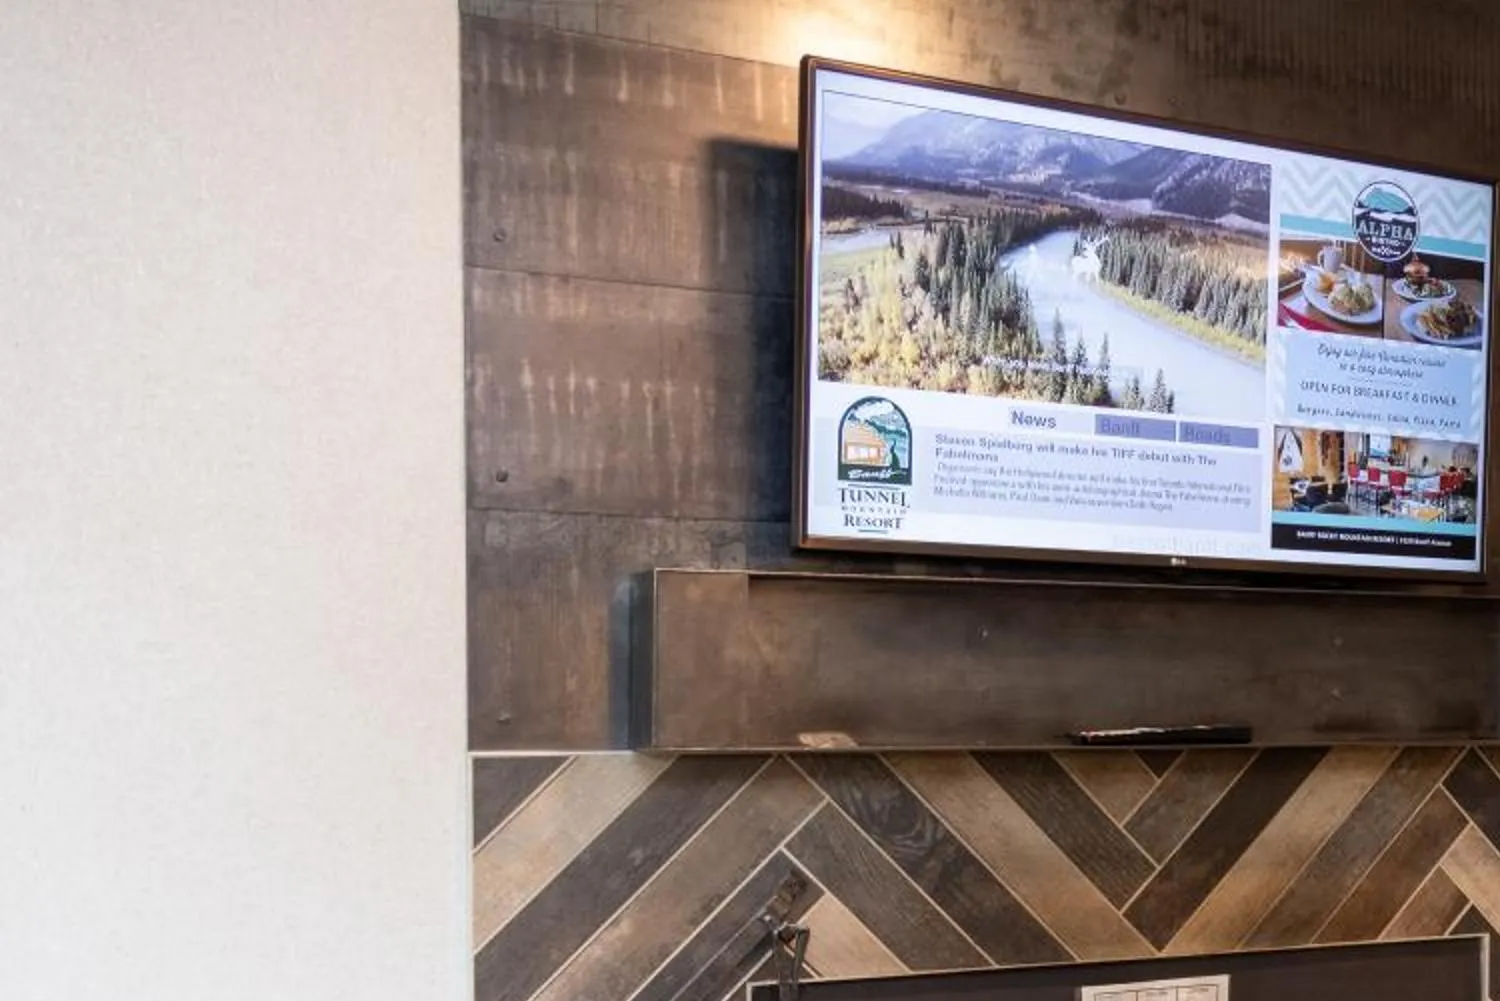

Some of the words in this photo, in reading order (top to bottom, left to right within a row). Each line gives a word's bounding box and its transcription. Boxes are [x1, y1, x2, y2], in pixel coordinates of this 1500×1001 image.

[1357, 219, 1413, 241] ALPHA
[1317, 343, 1341, 358] Enjoy
[1300, 381, 1329, 393] OPEN
[1332, 383, 1351, 396] FOR
[1353, 386, 1409, 401] BREAKFAST
[1412, 393, 1419, 402] &
[1422, 393, 1457, 406] DINNER
[1012, 409, 1057, 429] News
[1036, 442, 1055, 453] will
[1058, 443, 1089, 456] make
[1112, 447, 1135, 459] TIFF
[1138, 450, 1169, 462] debut
[1172, 452, 1194, 465] with
[1198, 455, 1217, 466] The
[838, 487, 907, 507] TUNNEL
[843, 513, 904, 529] RESORT
